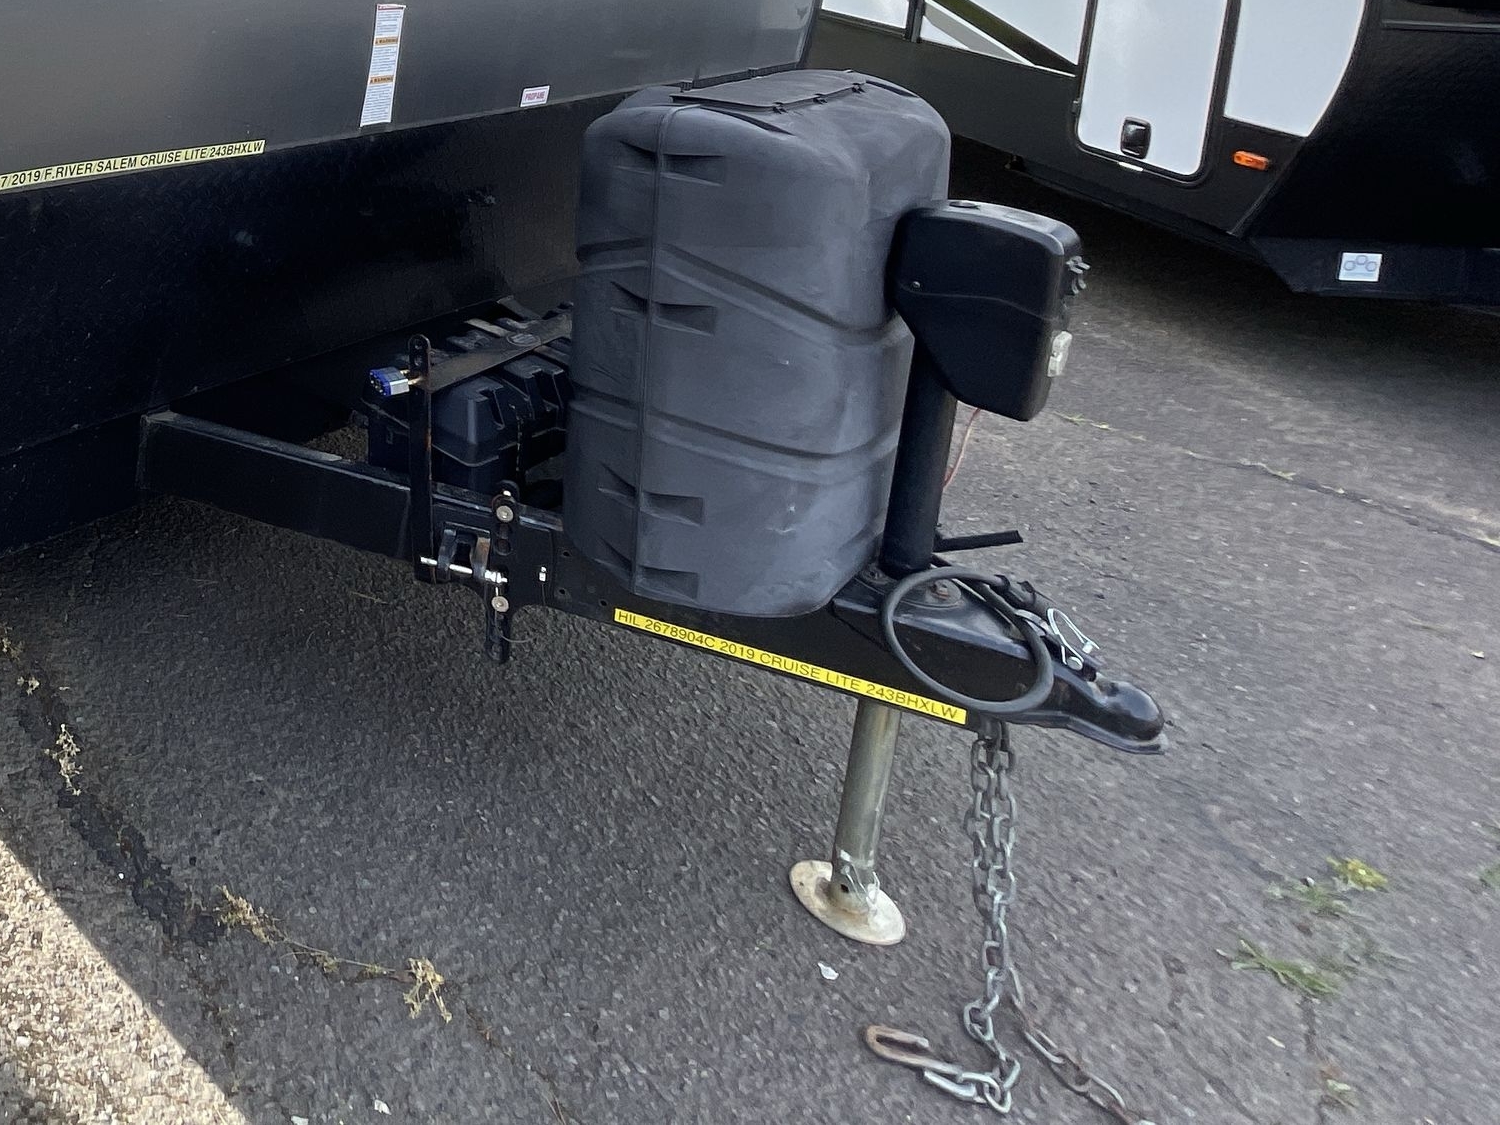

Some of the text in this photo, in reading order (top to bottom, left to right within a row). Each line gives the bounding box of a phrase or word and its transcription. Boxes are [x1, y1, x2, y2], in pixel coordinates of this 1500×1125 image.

[140, 150, 181, 167] CRUISE
[184, 141, 264, 161] LITE/243BHXLW
[617, 610, 958, 720] HIL 2678904C 2019 CRUISE LITE 243BHXLW
